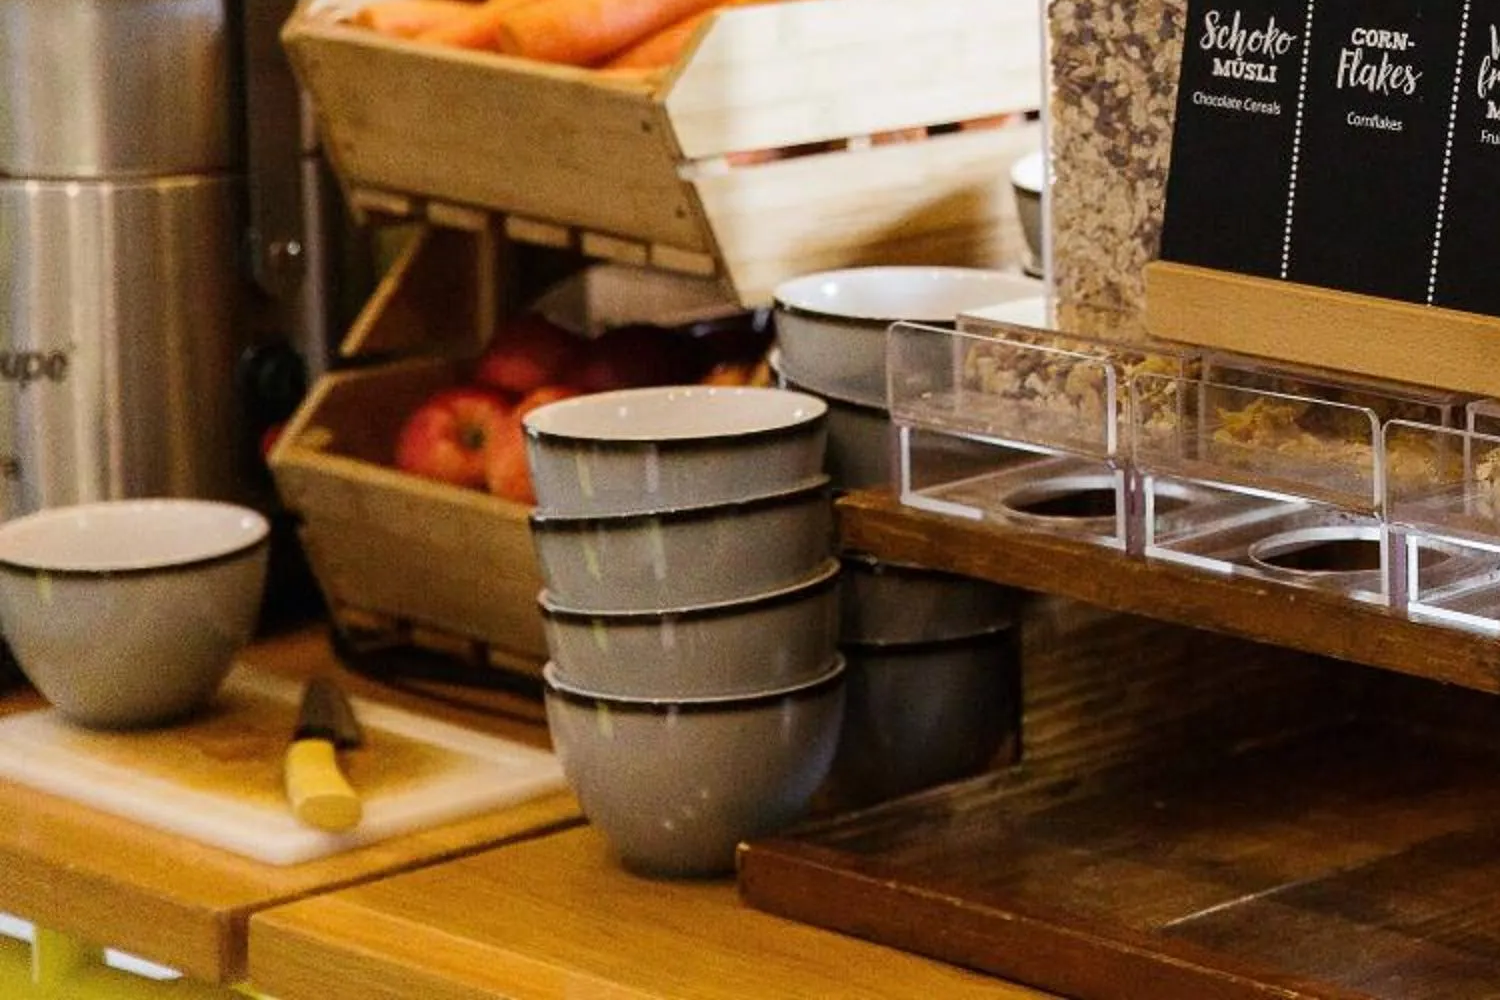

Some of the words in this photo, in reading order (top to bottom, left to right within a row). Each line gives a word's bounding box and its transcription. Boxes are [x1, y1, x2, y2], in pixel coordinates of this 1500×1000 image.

[1200, 10, 1297, 60] Schoko
[1351, 27, 1415, 51] CORN-
[1212, 57, 1278, 83] MÜSLI
[1337, 47, 1423, 96] Flakes
[1193, 91, 1241, 110] Chocolate
[1244, 98, 1281, 115] Cereals
[1347, 111, 1403, 131] Cornflakes
